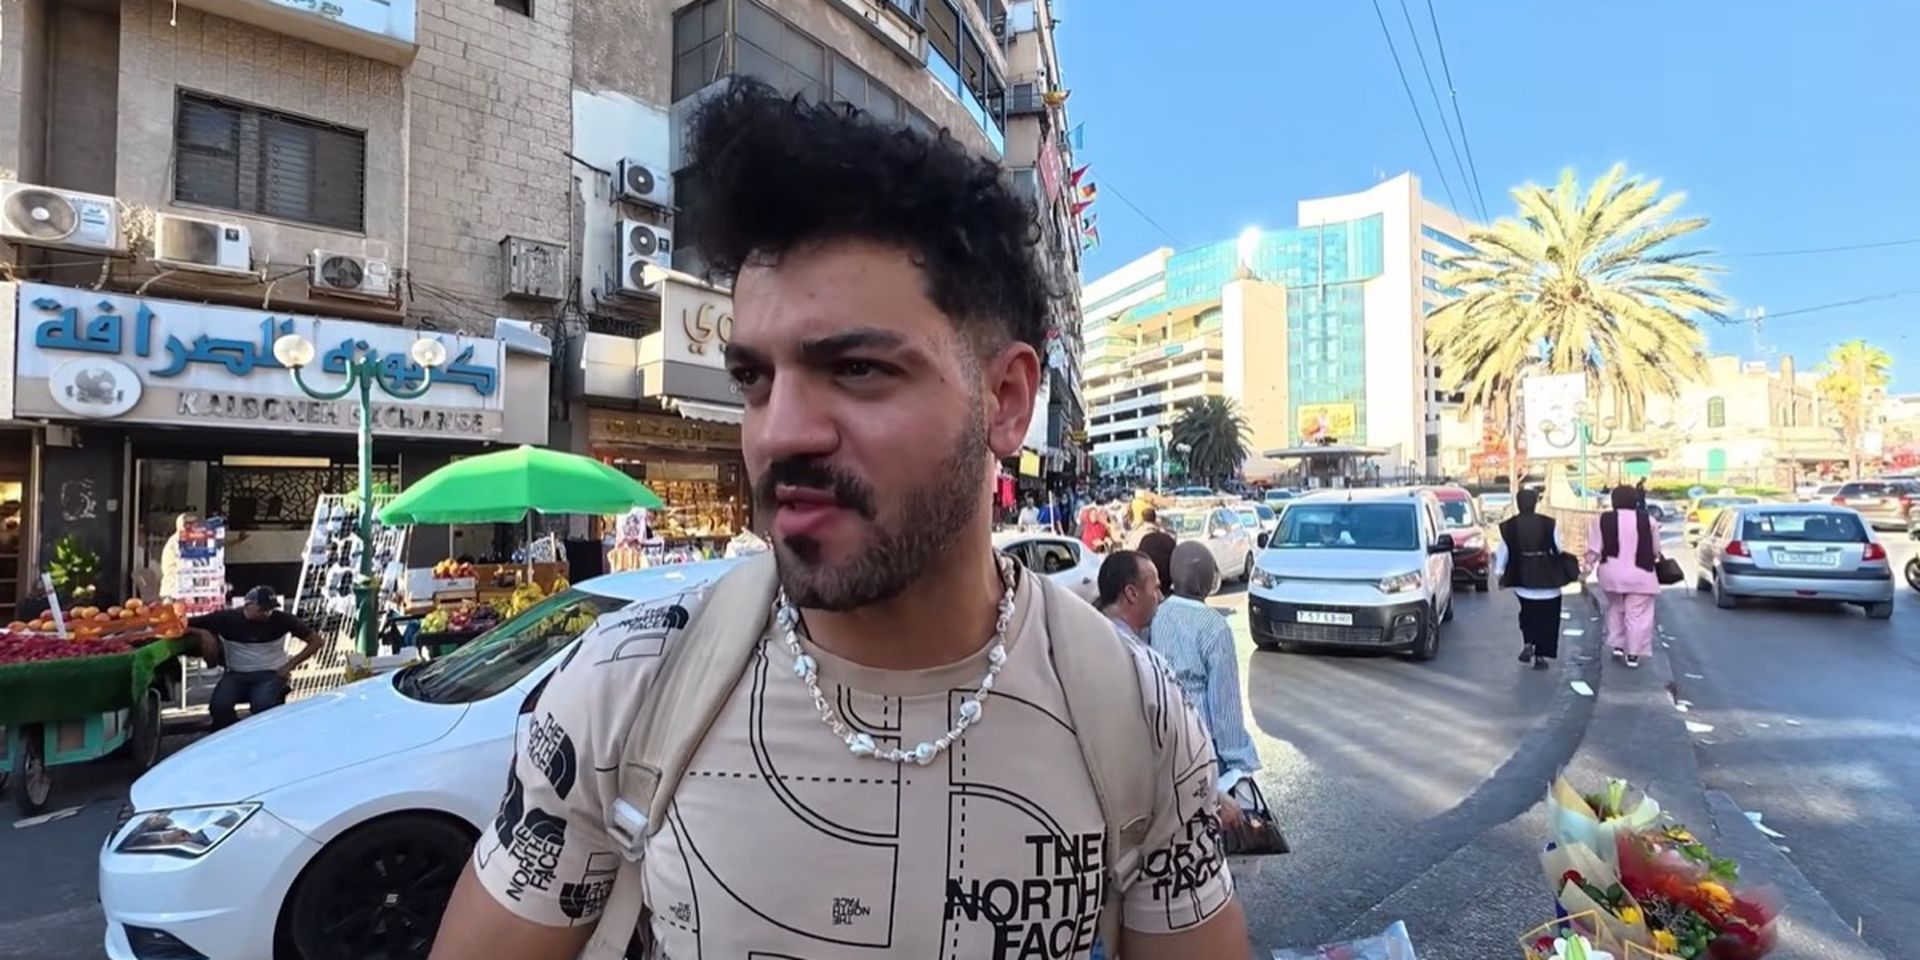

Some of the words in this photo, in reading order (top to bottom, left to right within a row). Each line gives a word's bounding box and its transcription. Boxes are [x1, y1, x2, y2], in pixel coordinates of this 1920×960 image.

[543, 712, 565, 742] THE
[508, 826, 532, 861] THE
[530, 842, 563, 892] FACE
[1025, 833, 1101, 876] THE
[506, 836, 544, 901] NORTH
[945, 873, 1101, 922] NORTH
[994, 912, 1096, 960] FACE
